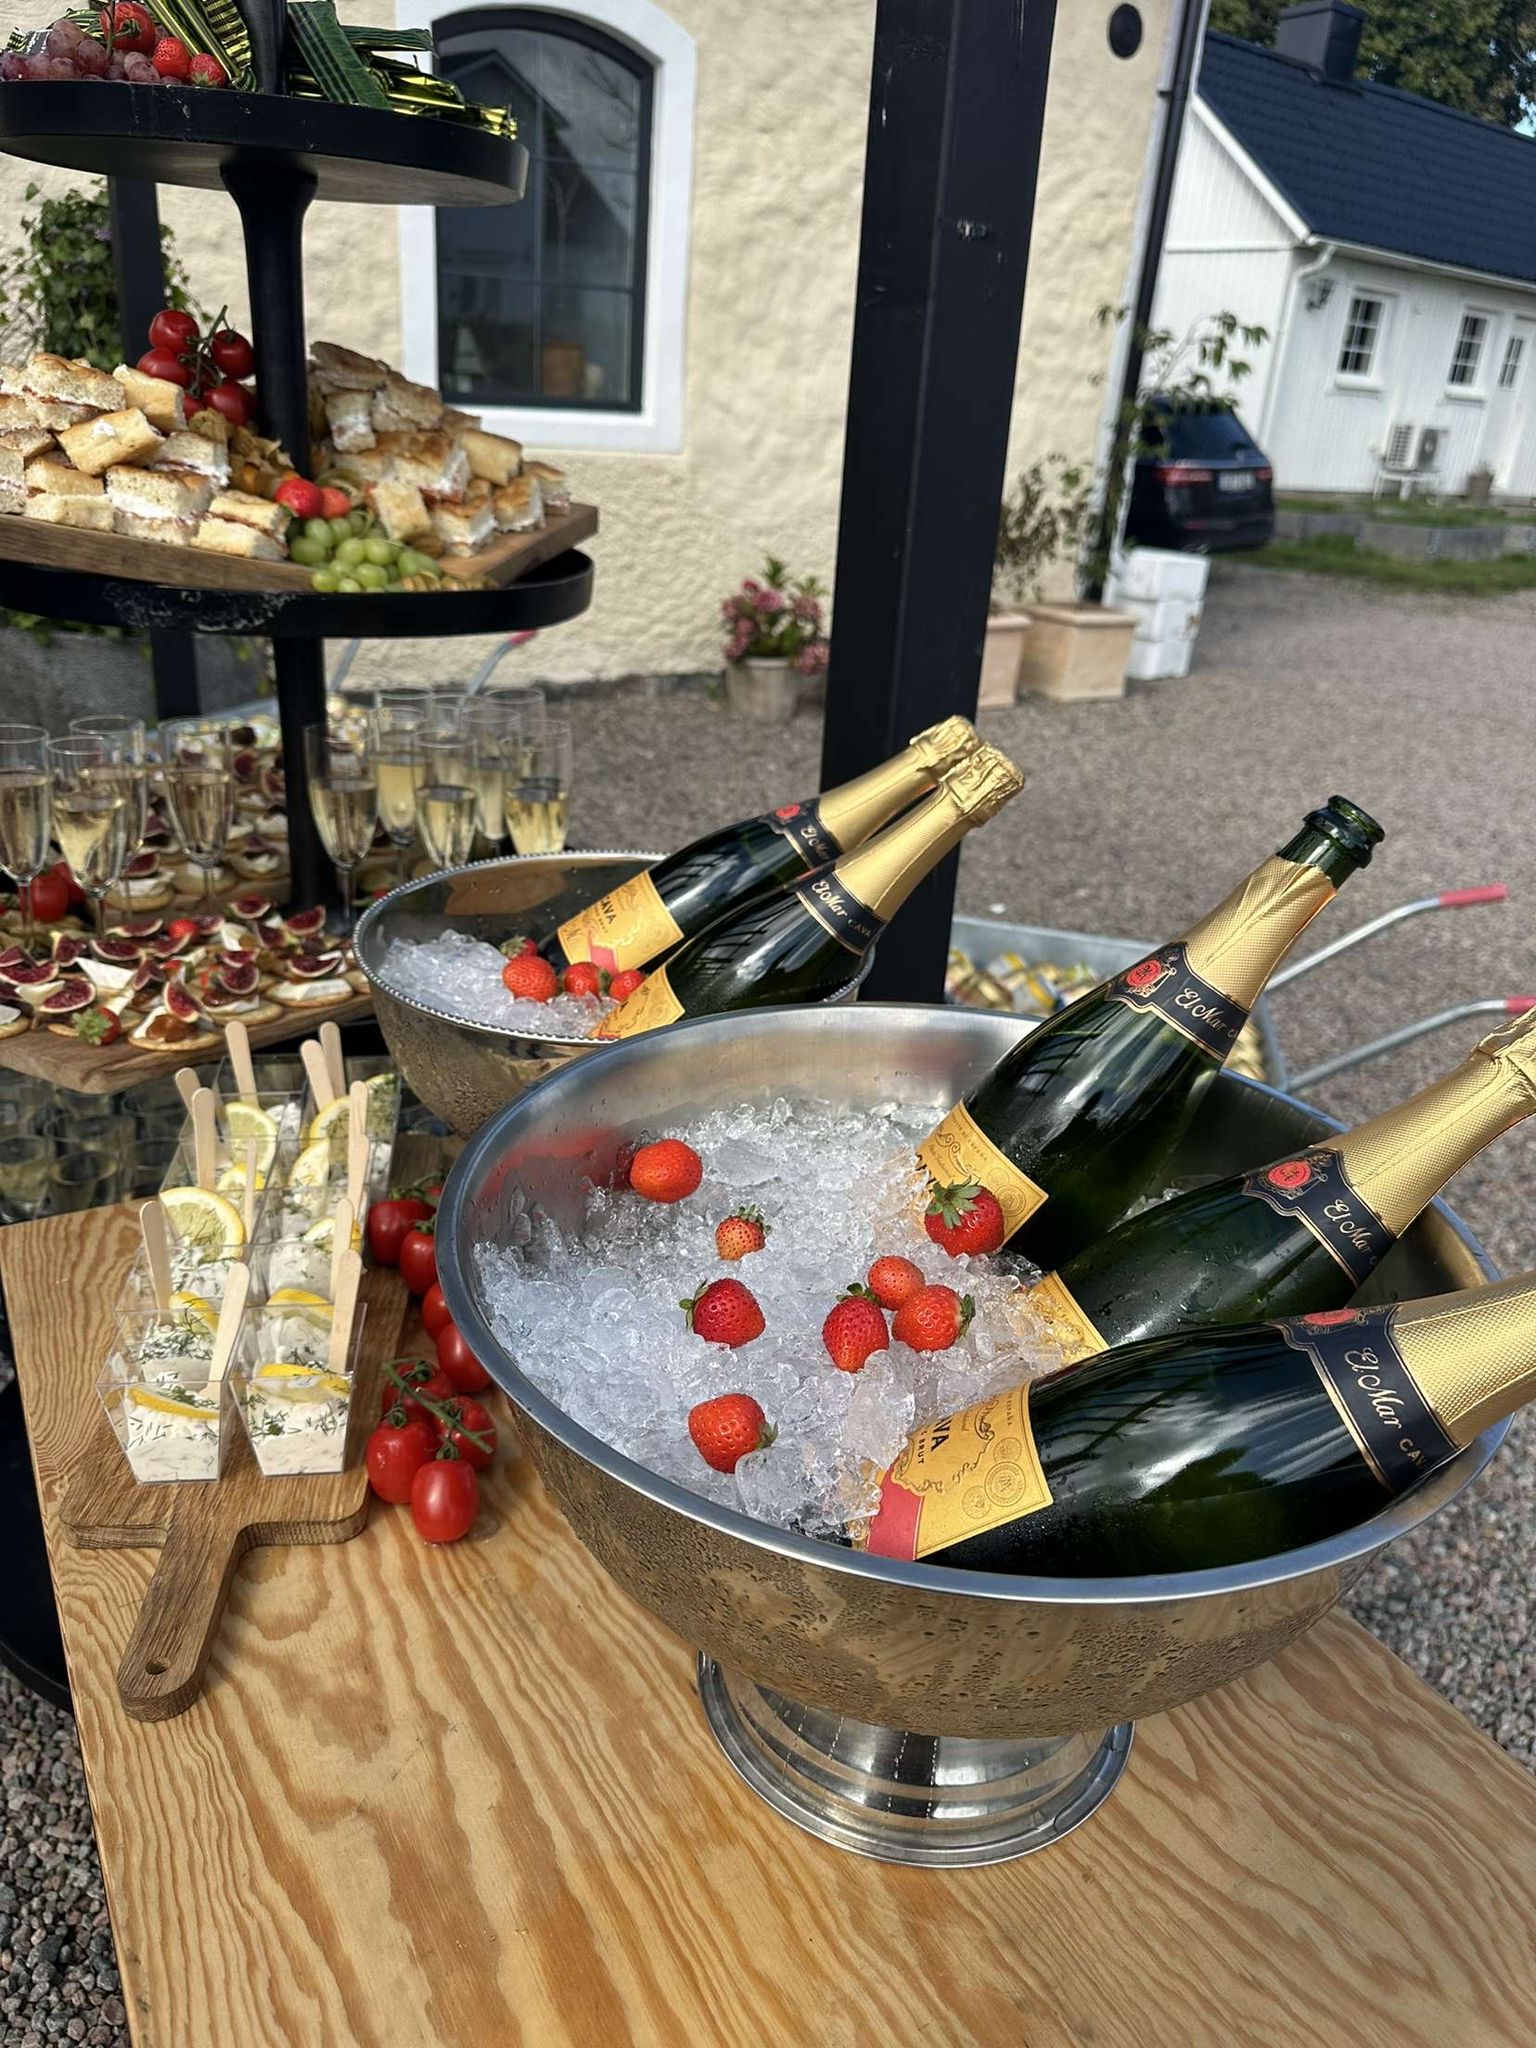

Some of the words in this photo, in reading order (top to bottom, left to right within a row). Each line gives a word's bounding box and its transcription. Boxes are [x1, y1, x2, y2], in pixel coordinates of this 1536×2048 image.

[811, 880, 830, 894] El
[819, 892, 848, 917] Mar
[1175, 987, 1201, 1010] El
[1191, 1004, 1228, 1031] Mar
[1323, 1198, 1351, 1222] El
[1339, 1220, 1373, 1254] Mar
[1344, 1346, 1380, 1373] El
[1357, 1374, 1405, 1429] Mar
[916, 1437, 926, 1465] BRUT
[1399, 1438, 1428, 1469] CAV
